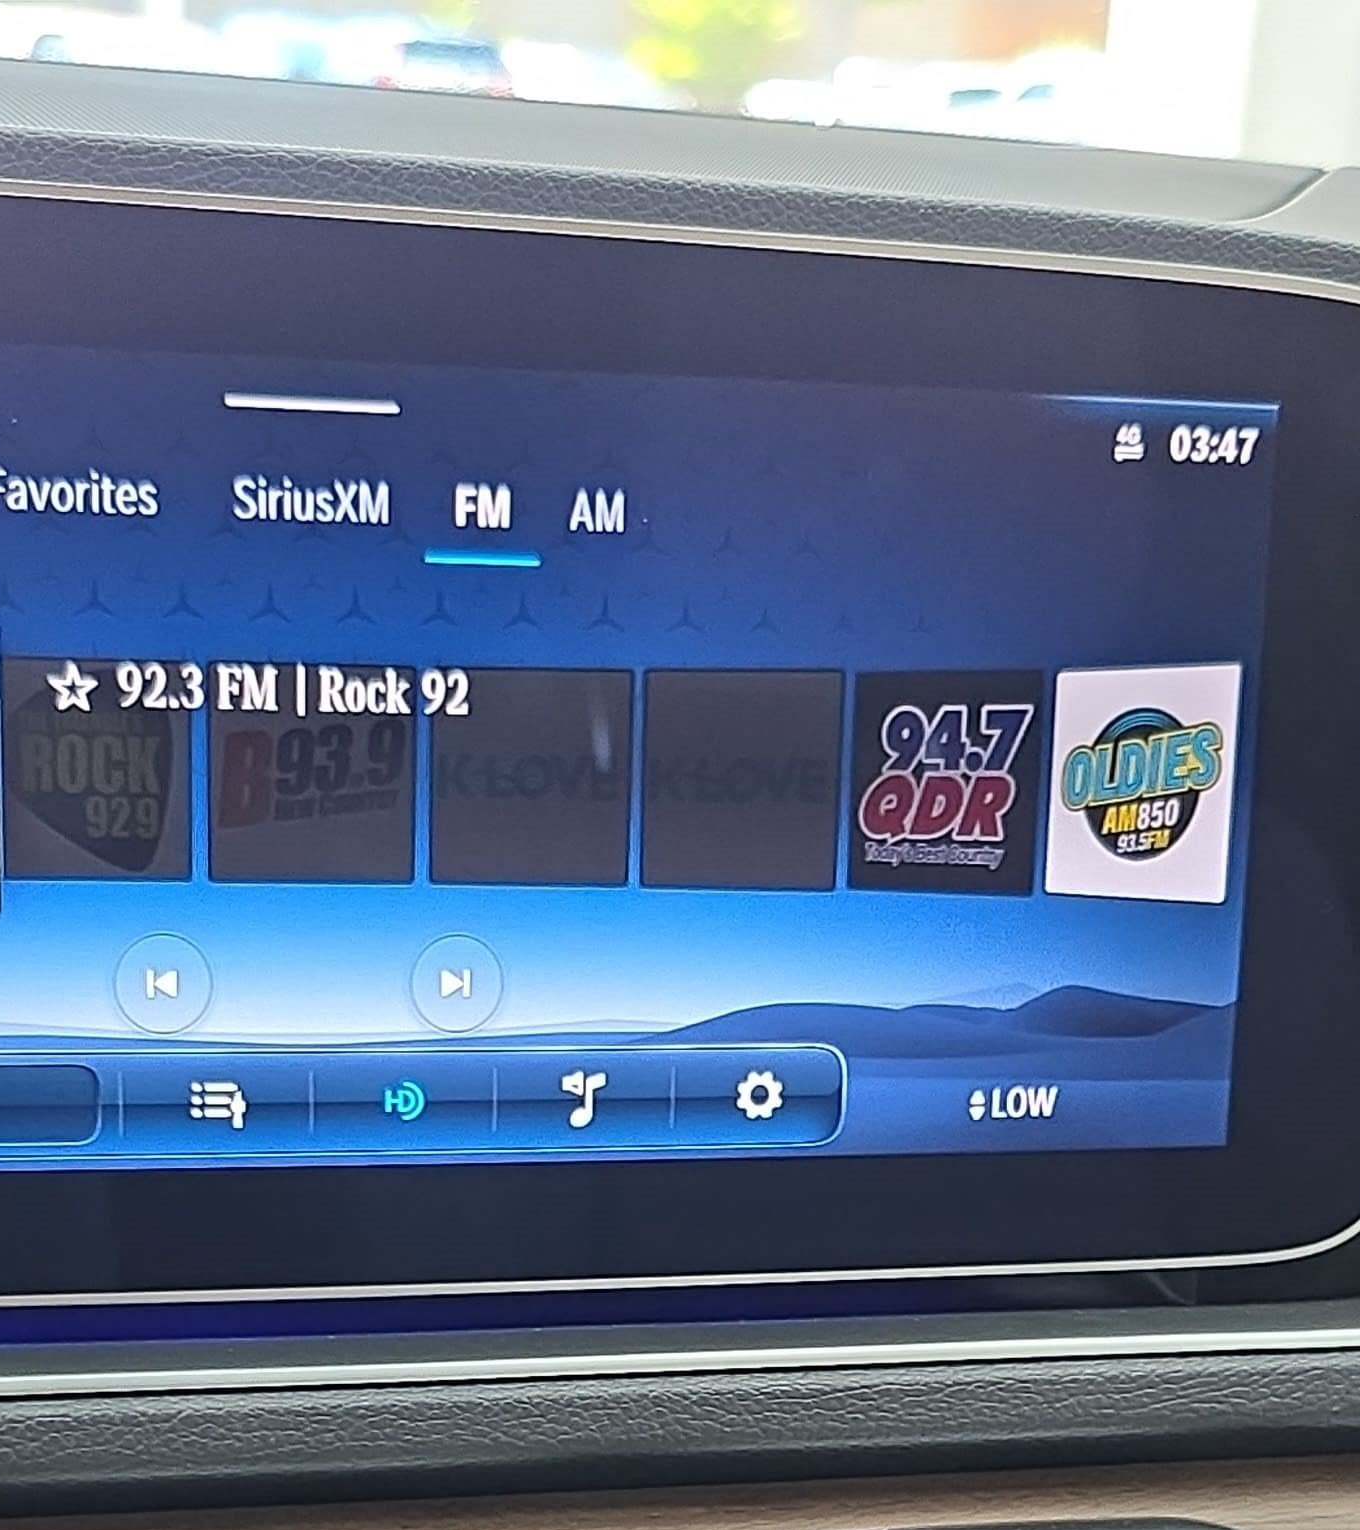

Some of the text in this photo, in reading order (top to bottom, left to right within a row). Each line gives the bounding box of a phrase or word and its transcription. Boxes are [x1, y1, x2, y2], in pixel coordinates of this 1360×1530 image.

[1168, 423, 1261, 465] 03:47
[232, 474, 390, 526] SiriusXM
[453, 482, 512, 530] FM
[568, 487, 626, 534] AM
[115, 661, 206, 711] 92.3
[215, 663, 280, 713] FM
[318, 664, 413, 716] Rock
[420, 667, 471, 717] 92
[19, 734, 162, 795] ROCK
[881, 704, 1036, 777] 94.7
[1060, 722, 1224, 811] OLDIES
[859, 771, 1016, 843] QDR
[992, 1086, 1059, 1121] LOW
